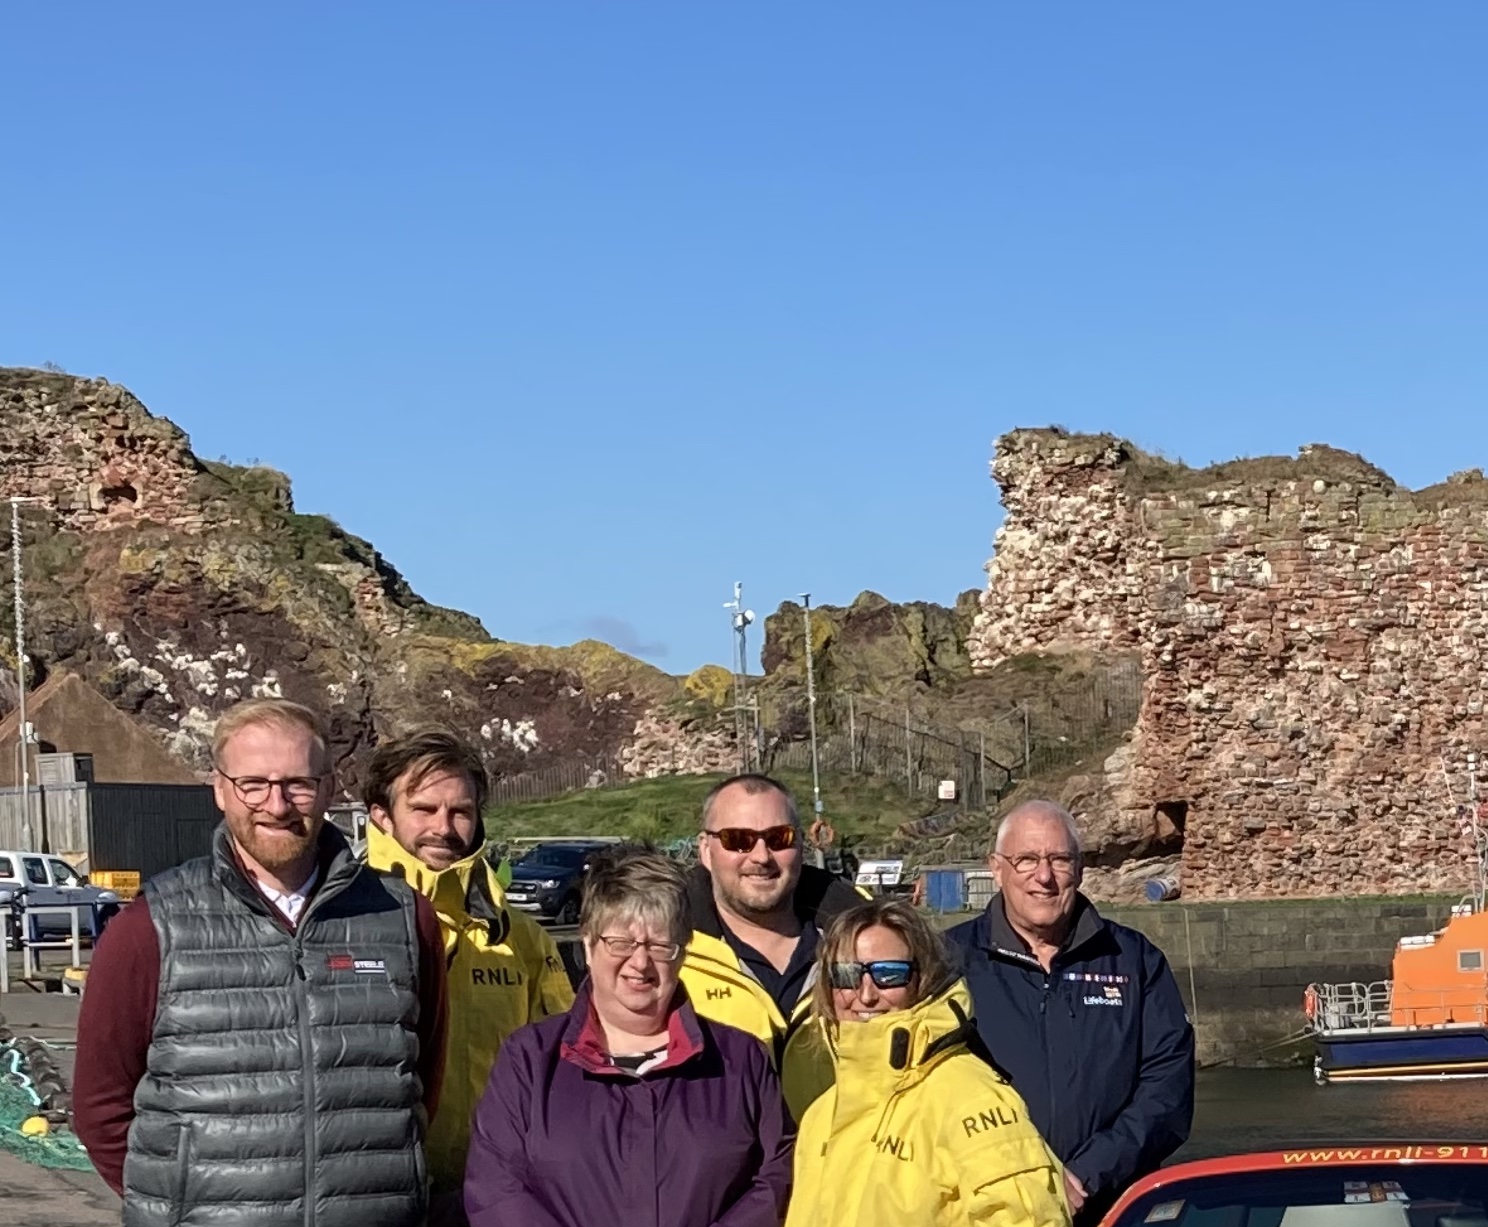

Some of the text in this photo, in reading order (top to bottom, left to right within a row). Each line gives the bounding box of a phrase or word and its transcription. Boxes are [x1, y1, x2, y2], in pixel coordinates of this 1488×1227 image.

[472, 967, 523, 986] RNLI
[706, 986, 732, 1000] HH
[961, 1106, 1019, 1138] RNLI
